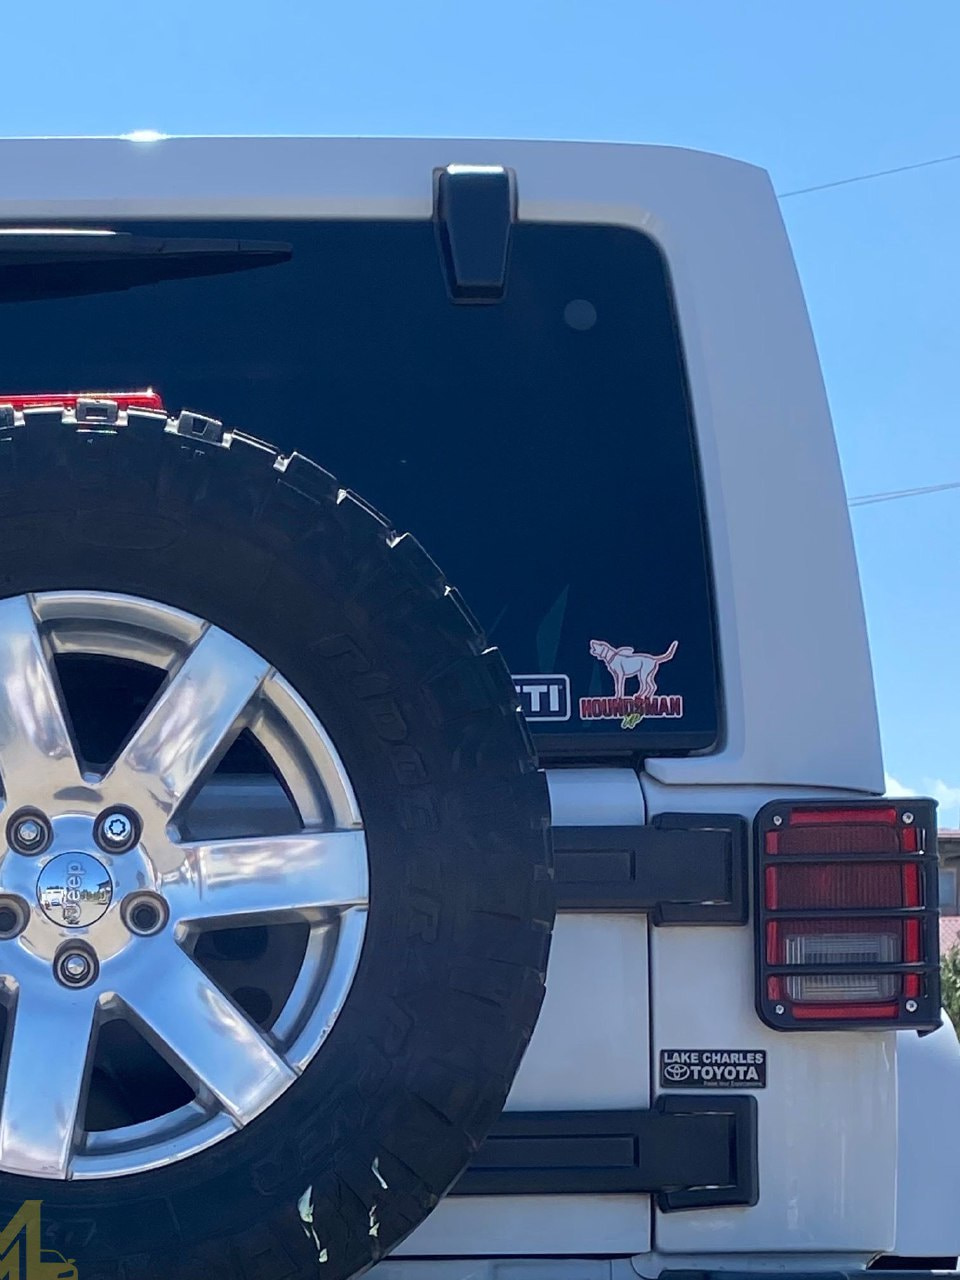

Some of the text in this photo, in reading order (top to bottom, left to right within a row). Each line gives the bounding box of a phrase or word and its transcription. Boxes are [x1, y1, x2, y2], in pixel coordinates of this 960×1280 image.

[515, 685, 559, 711] TI
[664, 1052, 764, 1064] LAKE CHARLES
[690, 1065, 759, 1081] TOYOTA
